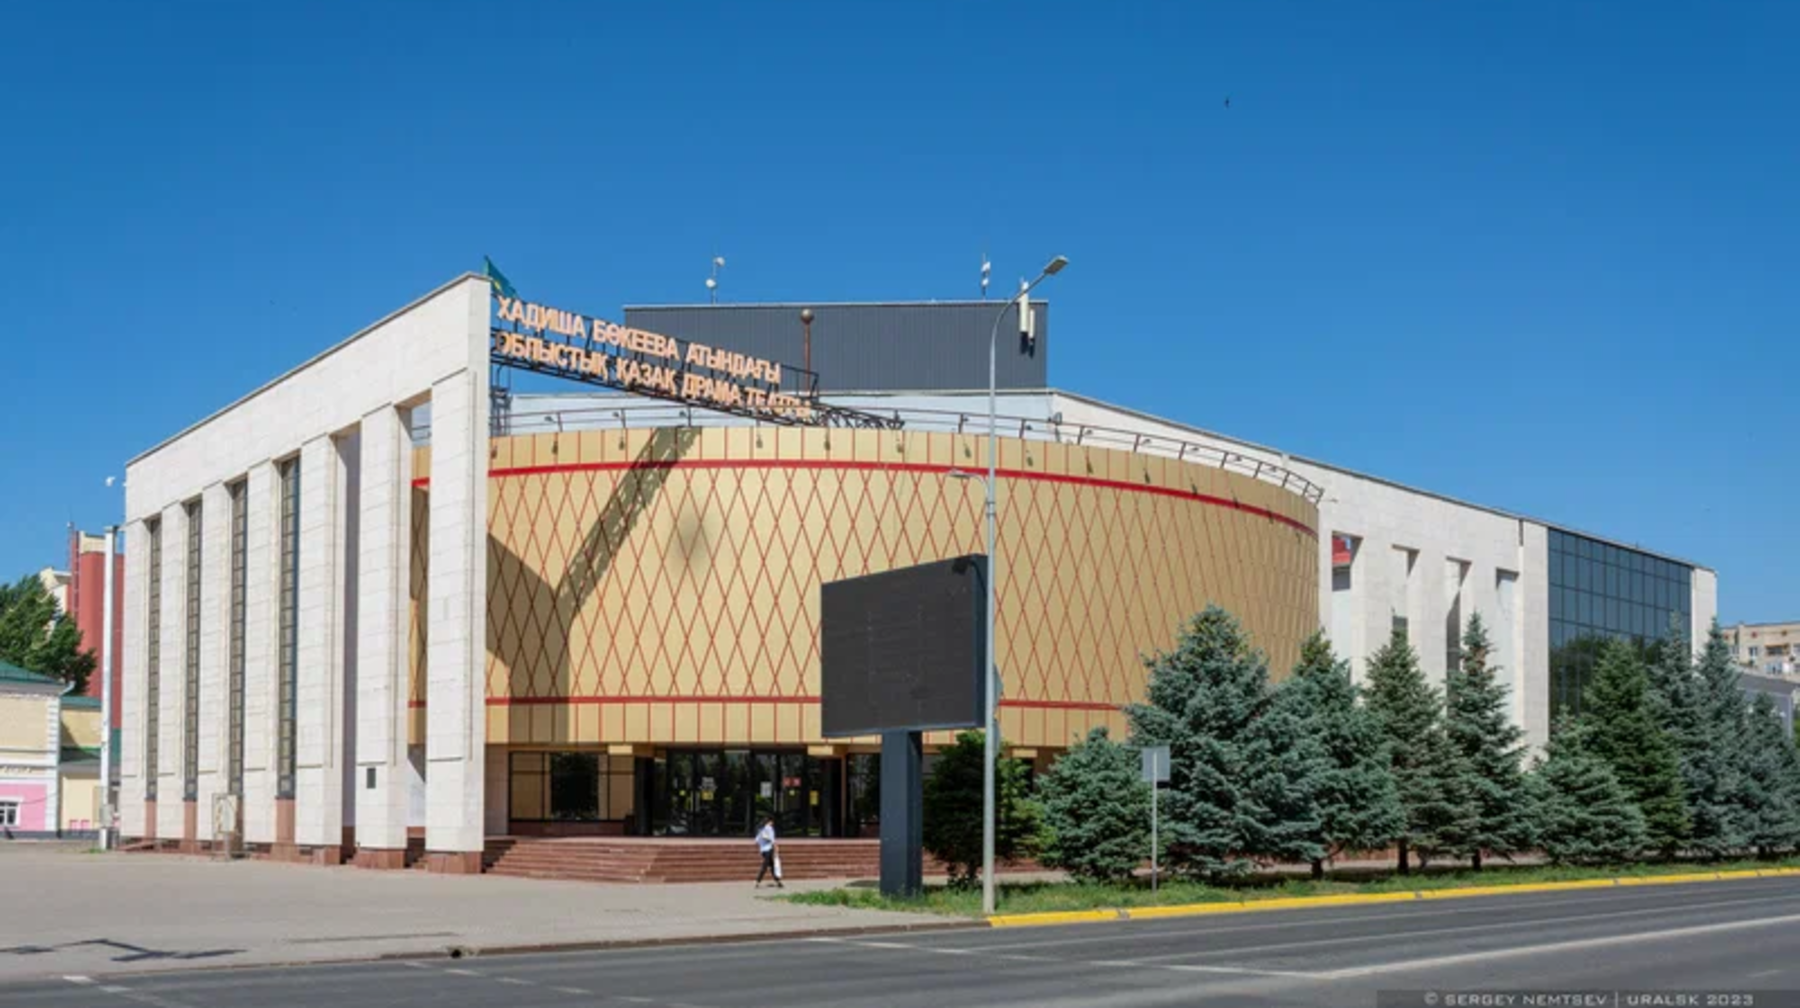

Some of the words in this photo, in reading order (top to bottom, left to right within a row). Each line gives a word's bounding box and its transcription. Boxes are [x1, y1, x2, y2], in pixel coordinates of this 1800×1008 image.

[497, 296, 587, 339] ХАДИША
[495, 332, 609, 380] ОБЛЫСТЫҚ
[616, 357, 677, 396] ҚАЗАҚ
[681, 373, 742, 406] ДРАМА
